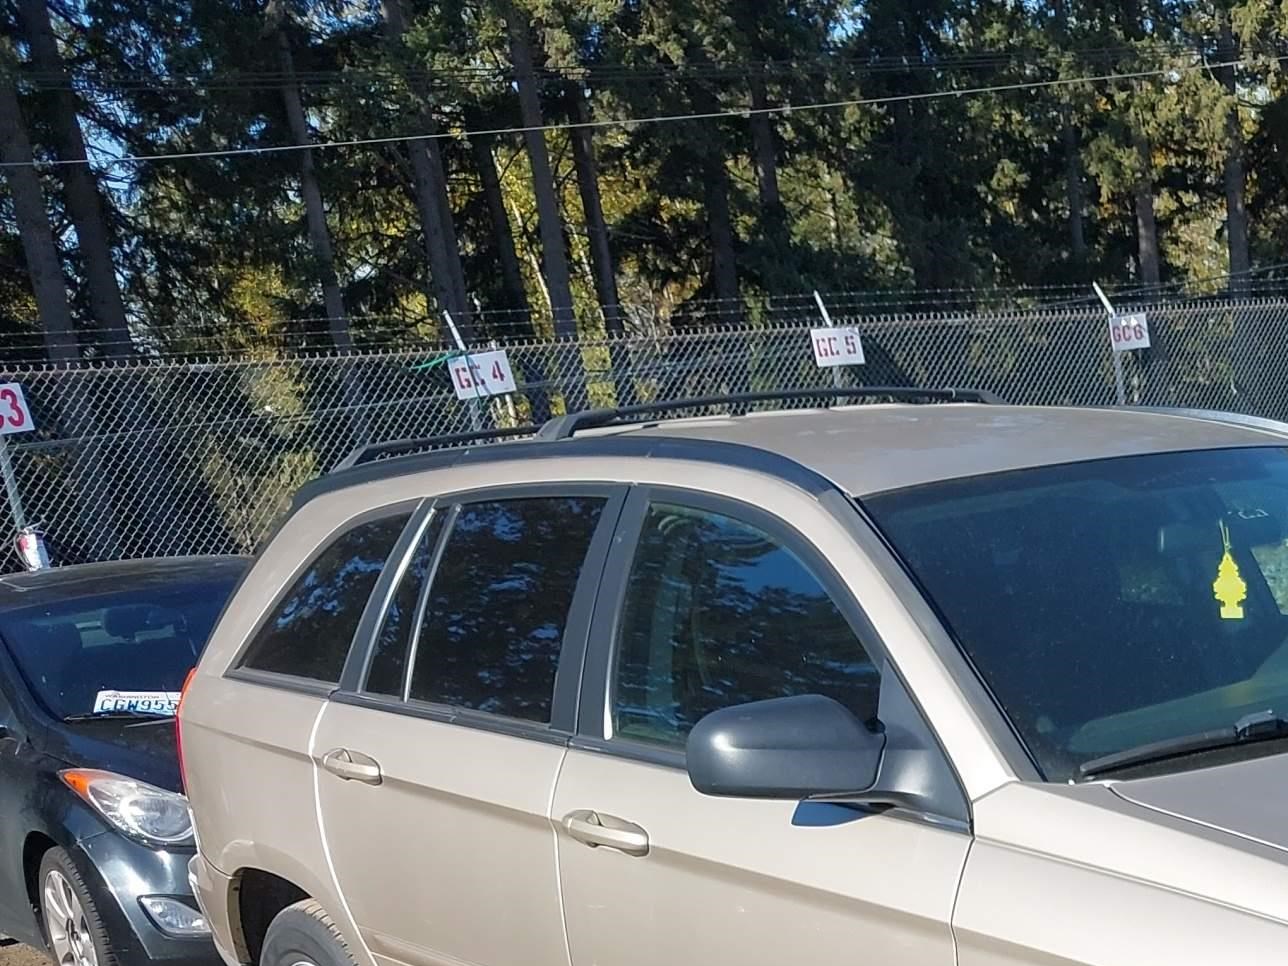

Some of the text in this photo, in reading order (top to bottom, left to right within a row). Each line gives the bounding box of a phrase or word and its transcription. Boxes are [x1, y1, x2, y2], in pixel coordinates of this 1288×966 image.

[816, 335, 857, 358] GC 5
[492, 360, 505, 382] 4
[0, 388, 25, 429] 3
